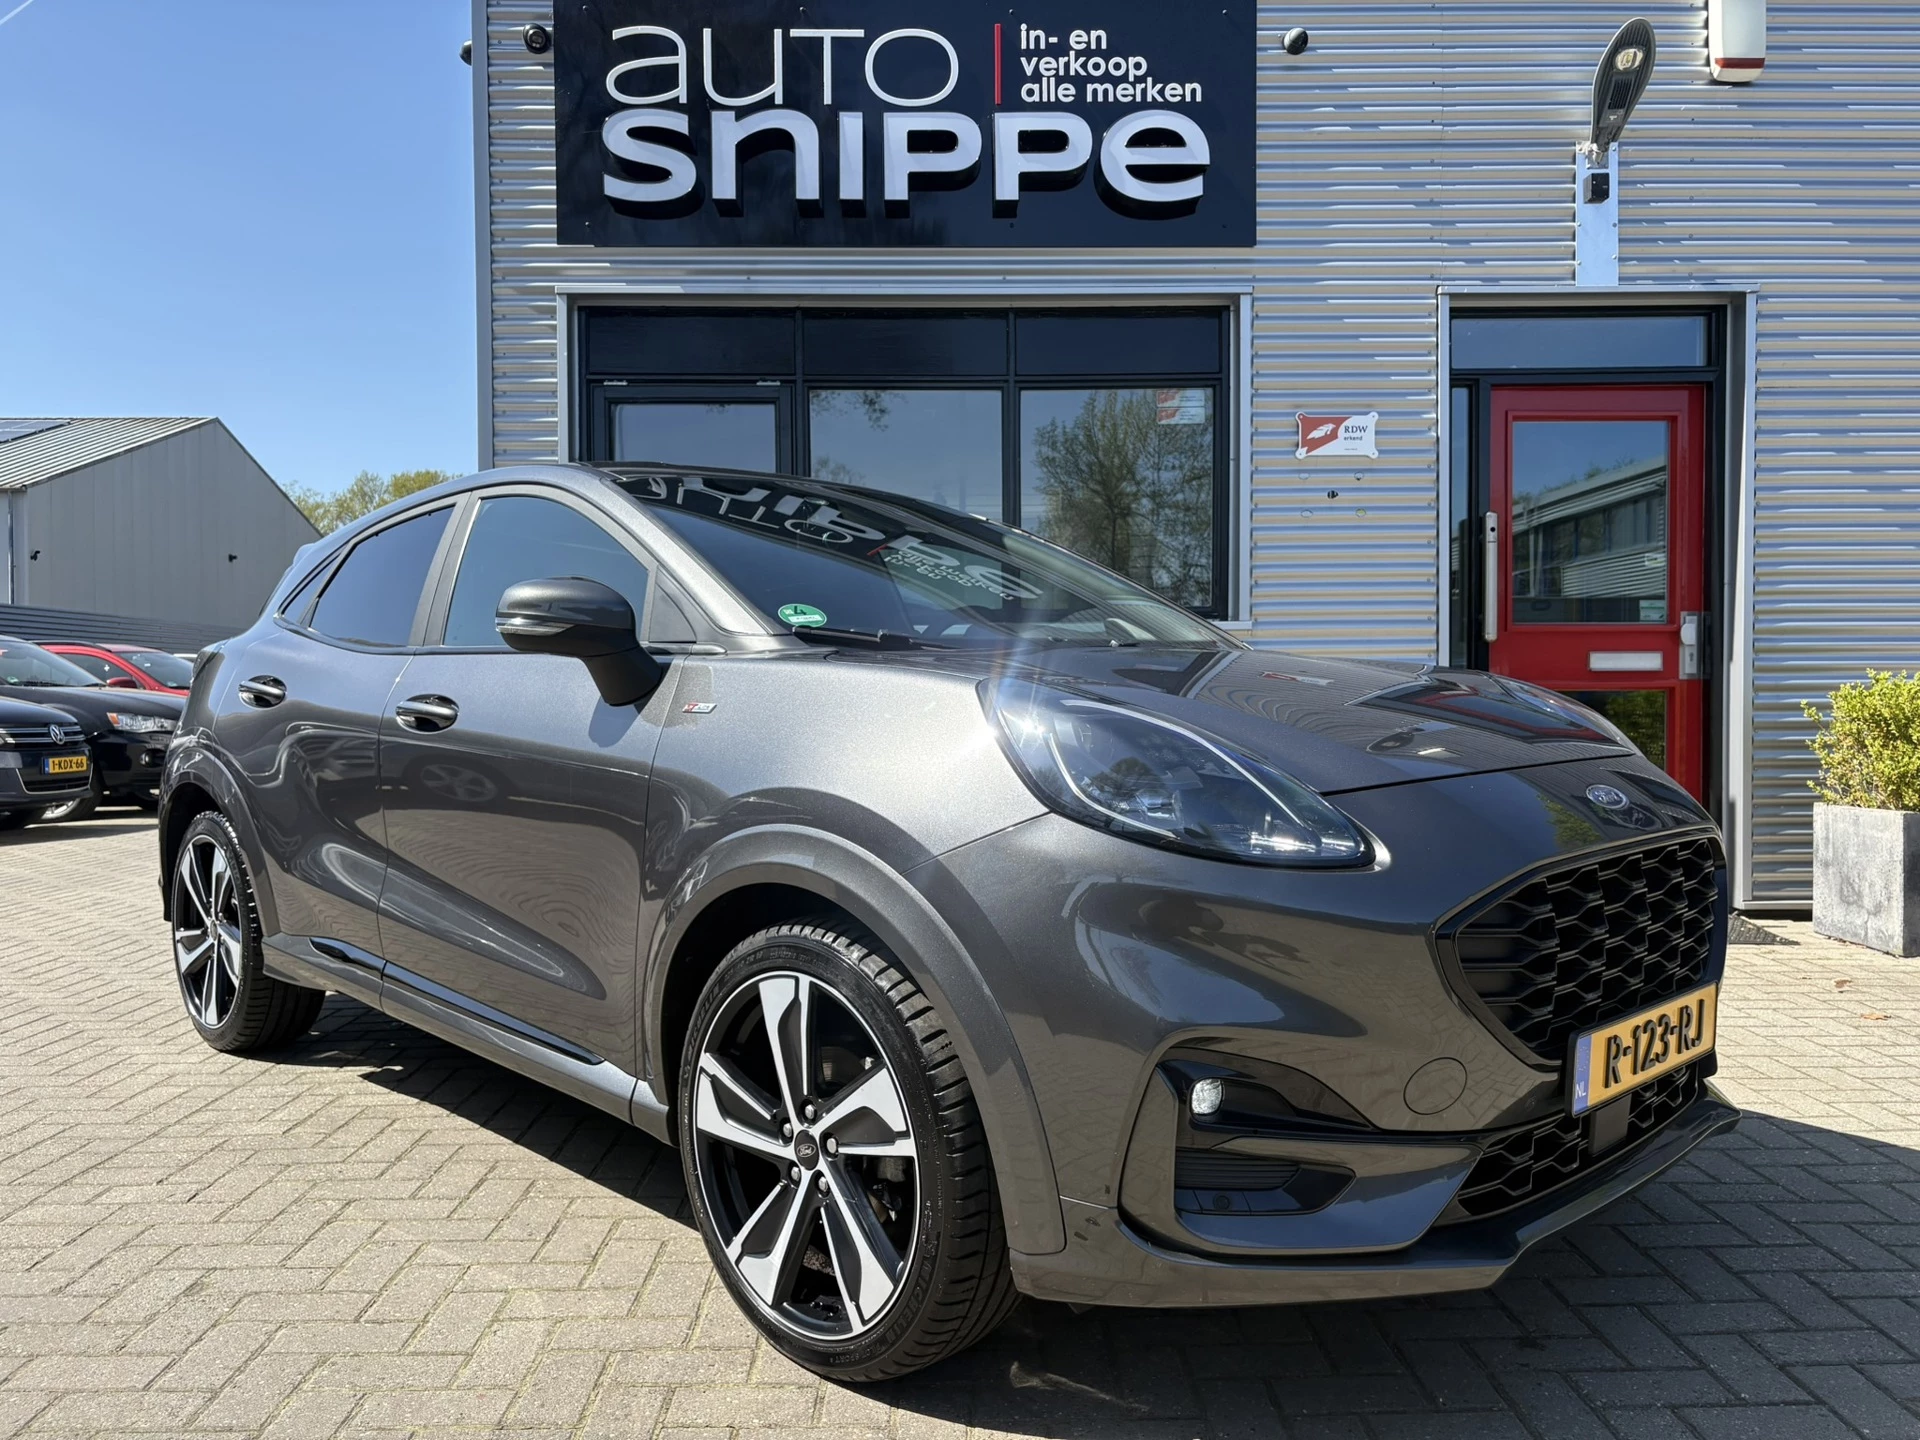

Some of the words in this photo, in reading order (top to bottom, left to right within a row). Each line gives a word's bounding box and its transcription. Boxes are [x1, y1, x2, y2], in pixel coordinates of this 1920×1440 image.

[1020, 23, 1058, 51] in-
[1069, 30, 1107, 51] en
[1020, 52, 1147, 83] verkoop
[1020, 78, 1079, 104] alle
[1086, 78, 1202, 104] merken
[1344, 425, 1368, 434] RDW
[52, 758, 85, 771] 1-KDX-66
[1602, 999, 1706, 1089] R-123-RJ
[1575, 1081, 1588, 1099] NL
